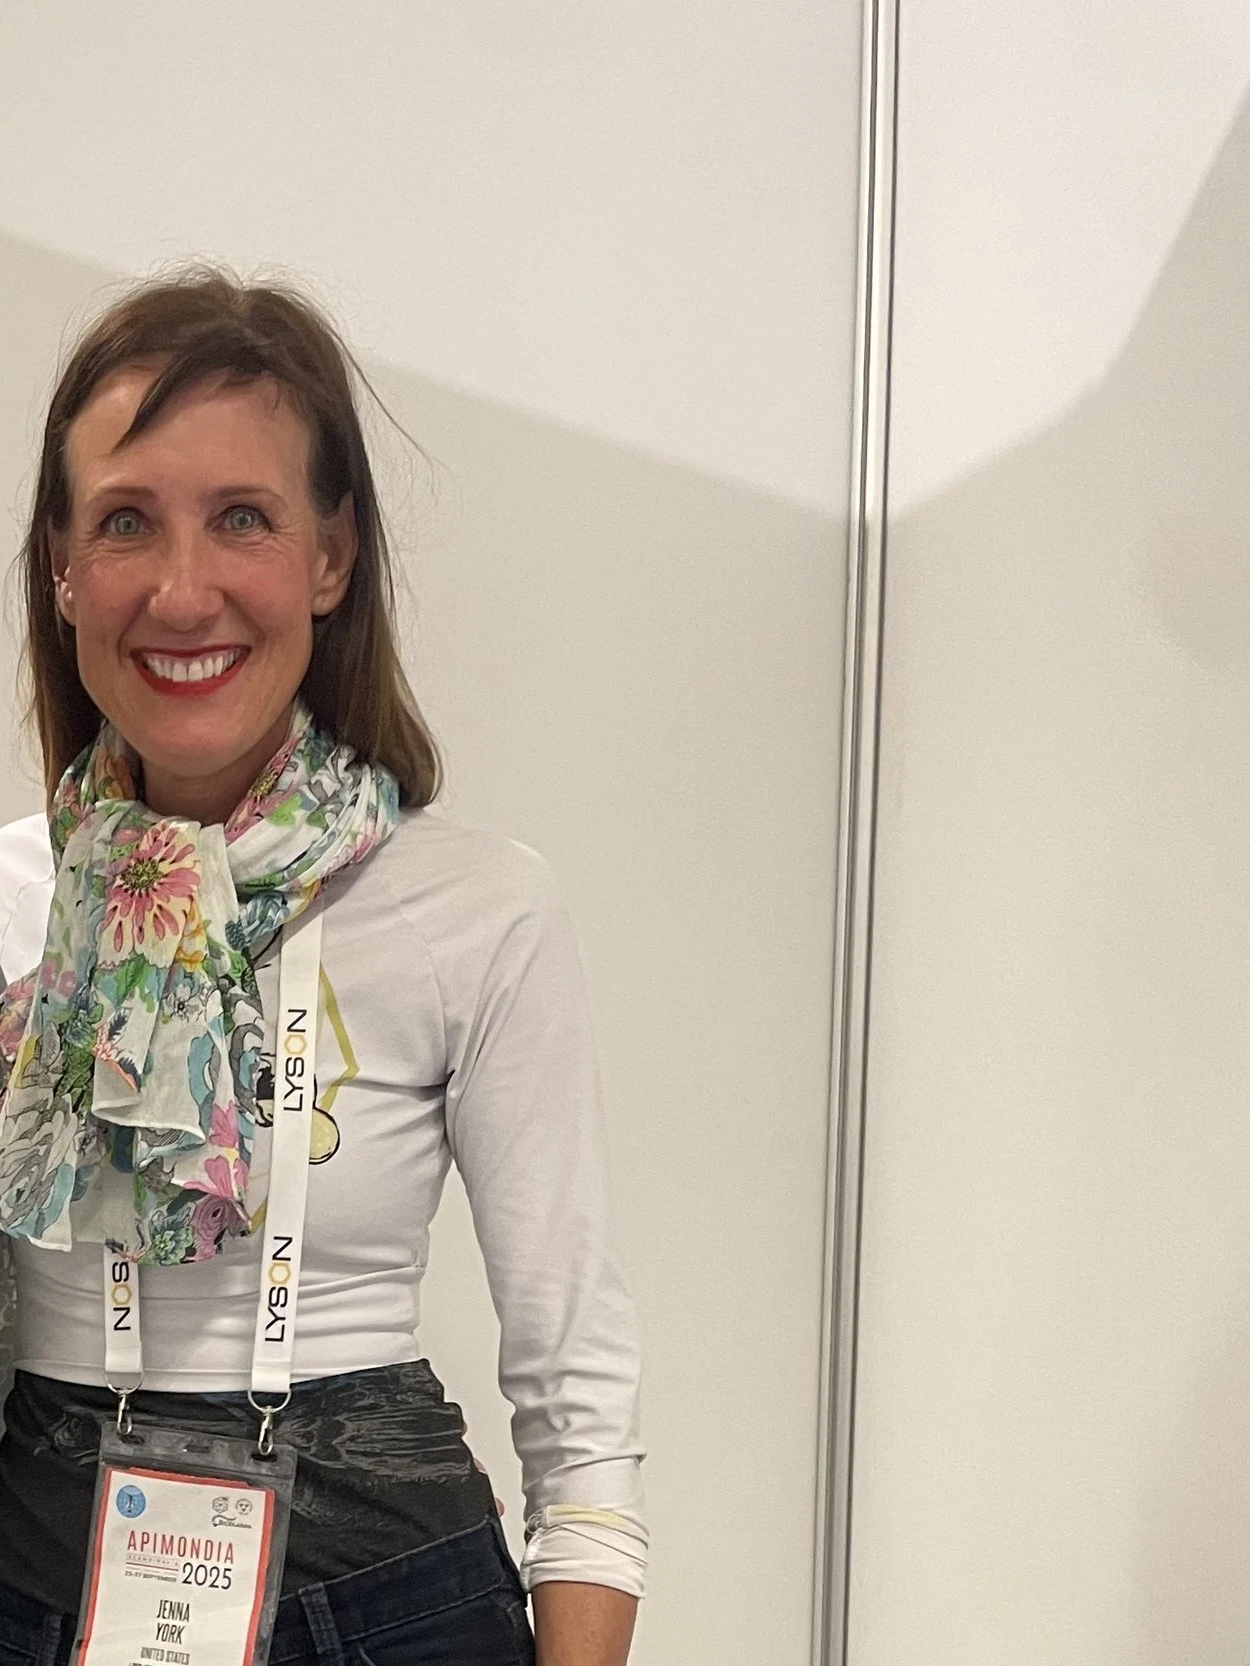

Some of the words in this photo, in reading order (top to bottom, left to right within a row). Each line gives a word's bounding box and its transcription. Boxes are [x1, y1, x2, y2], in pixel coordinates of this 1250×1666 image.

[284, 1009, 307, 1112] LYSON
[111, 1261, 132, 1330] SON
[265, 1236, 293, 1342] LYSON
[127, 1530, 234, 1564] APIMONDIA
[182, 1562, 232, 1590] 2025
[156, 1600, 190, 1622] JENNA
[156, 1622, 185, 1644] YORK
[141, 1647, 165, 1661] UNITED
[166, 1651, 190, 1665] STATES
